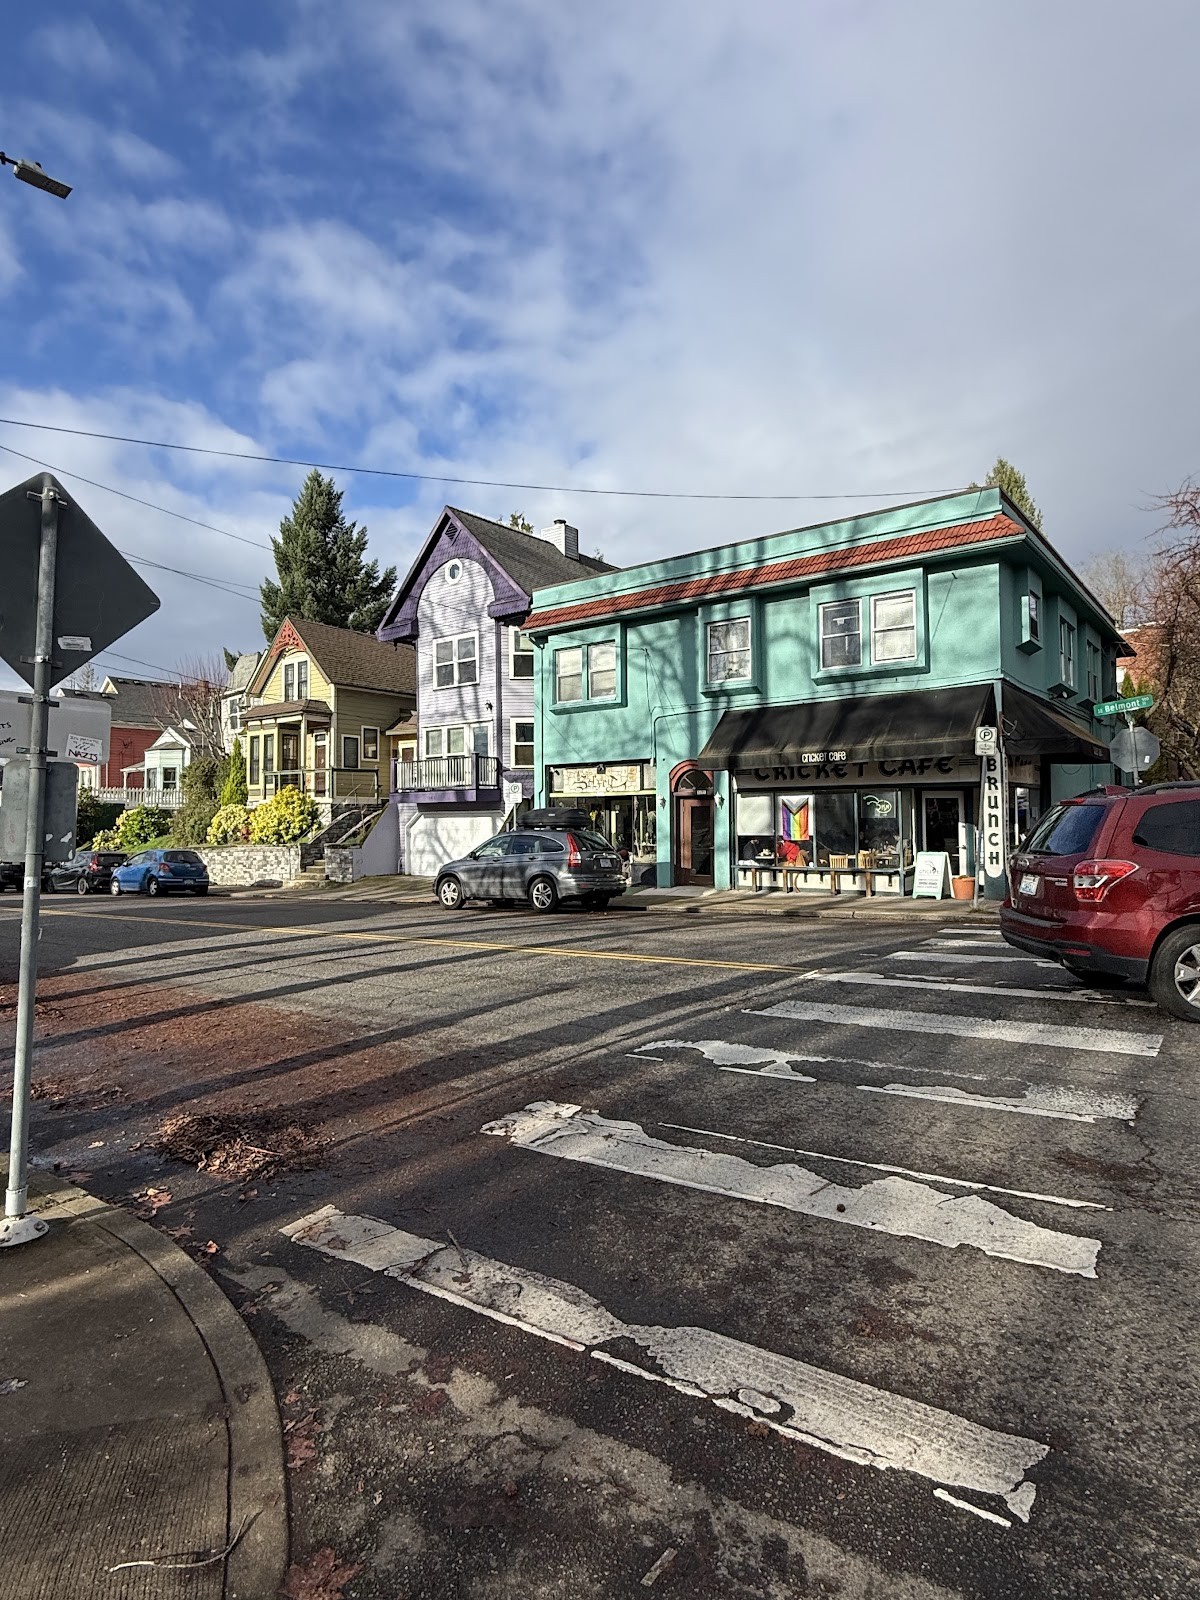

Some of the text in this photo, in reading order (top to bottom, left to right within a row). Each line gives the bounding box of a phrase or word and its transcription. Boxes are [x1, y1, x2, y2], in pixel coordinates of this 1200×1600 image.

[1104, 699, 1140, 713] Belmont
[68, 748, 98, 762] NAZIS
[754, 756, 956, 781] CRICKET CAFE
